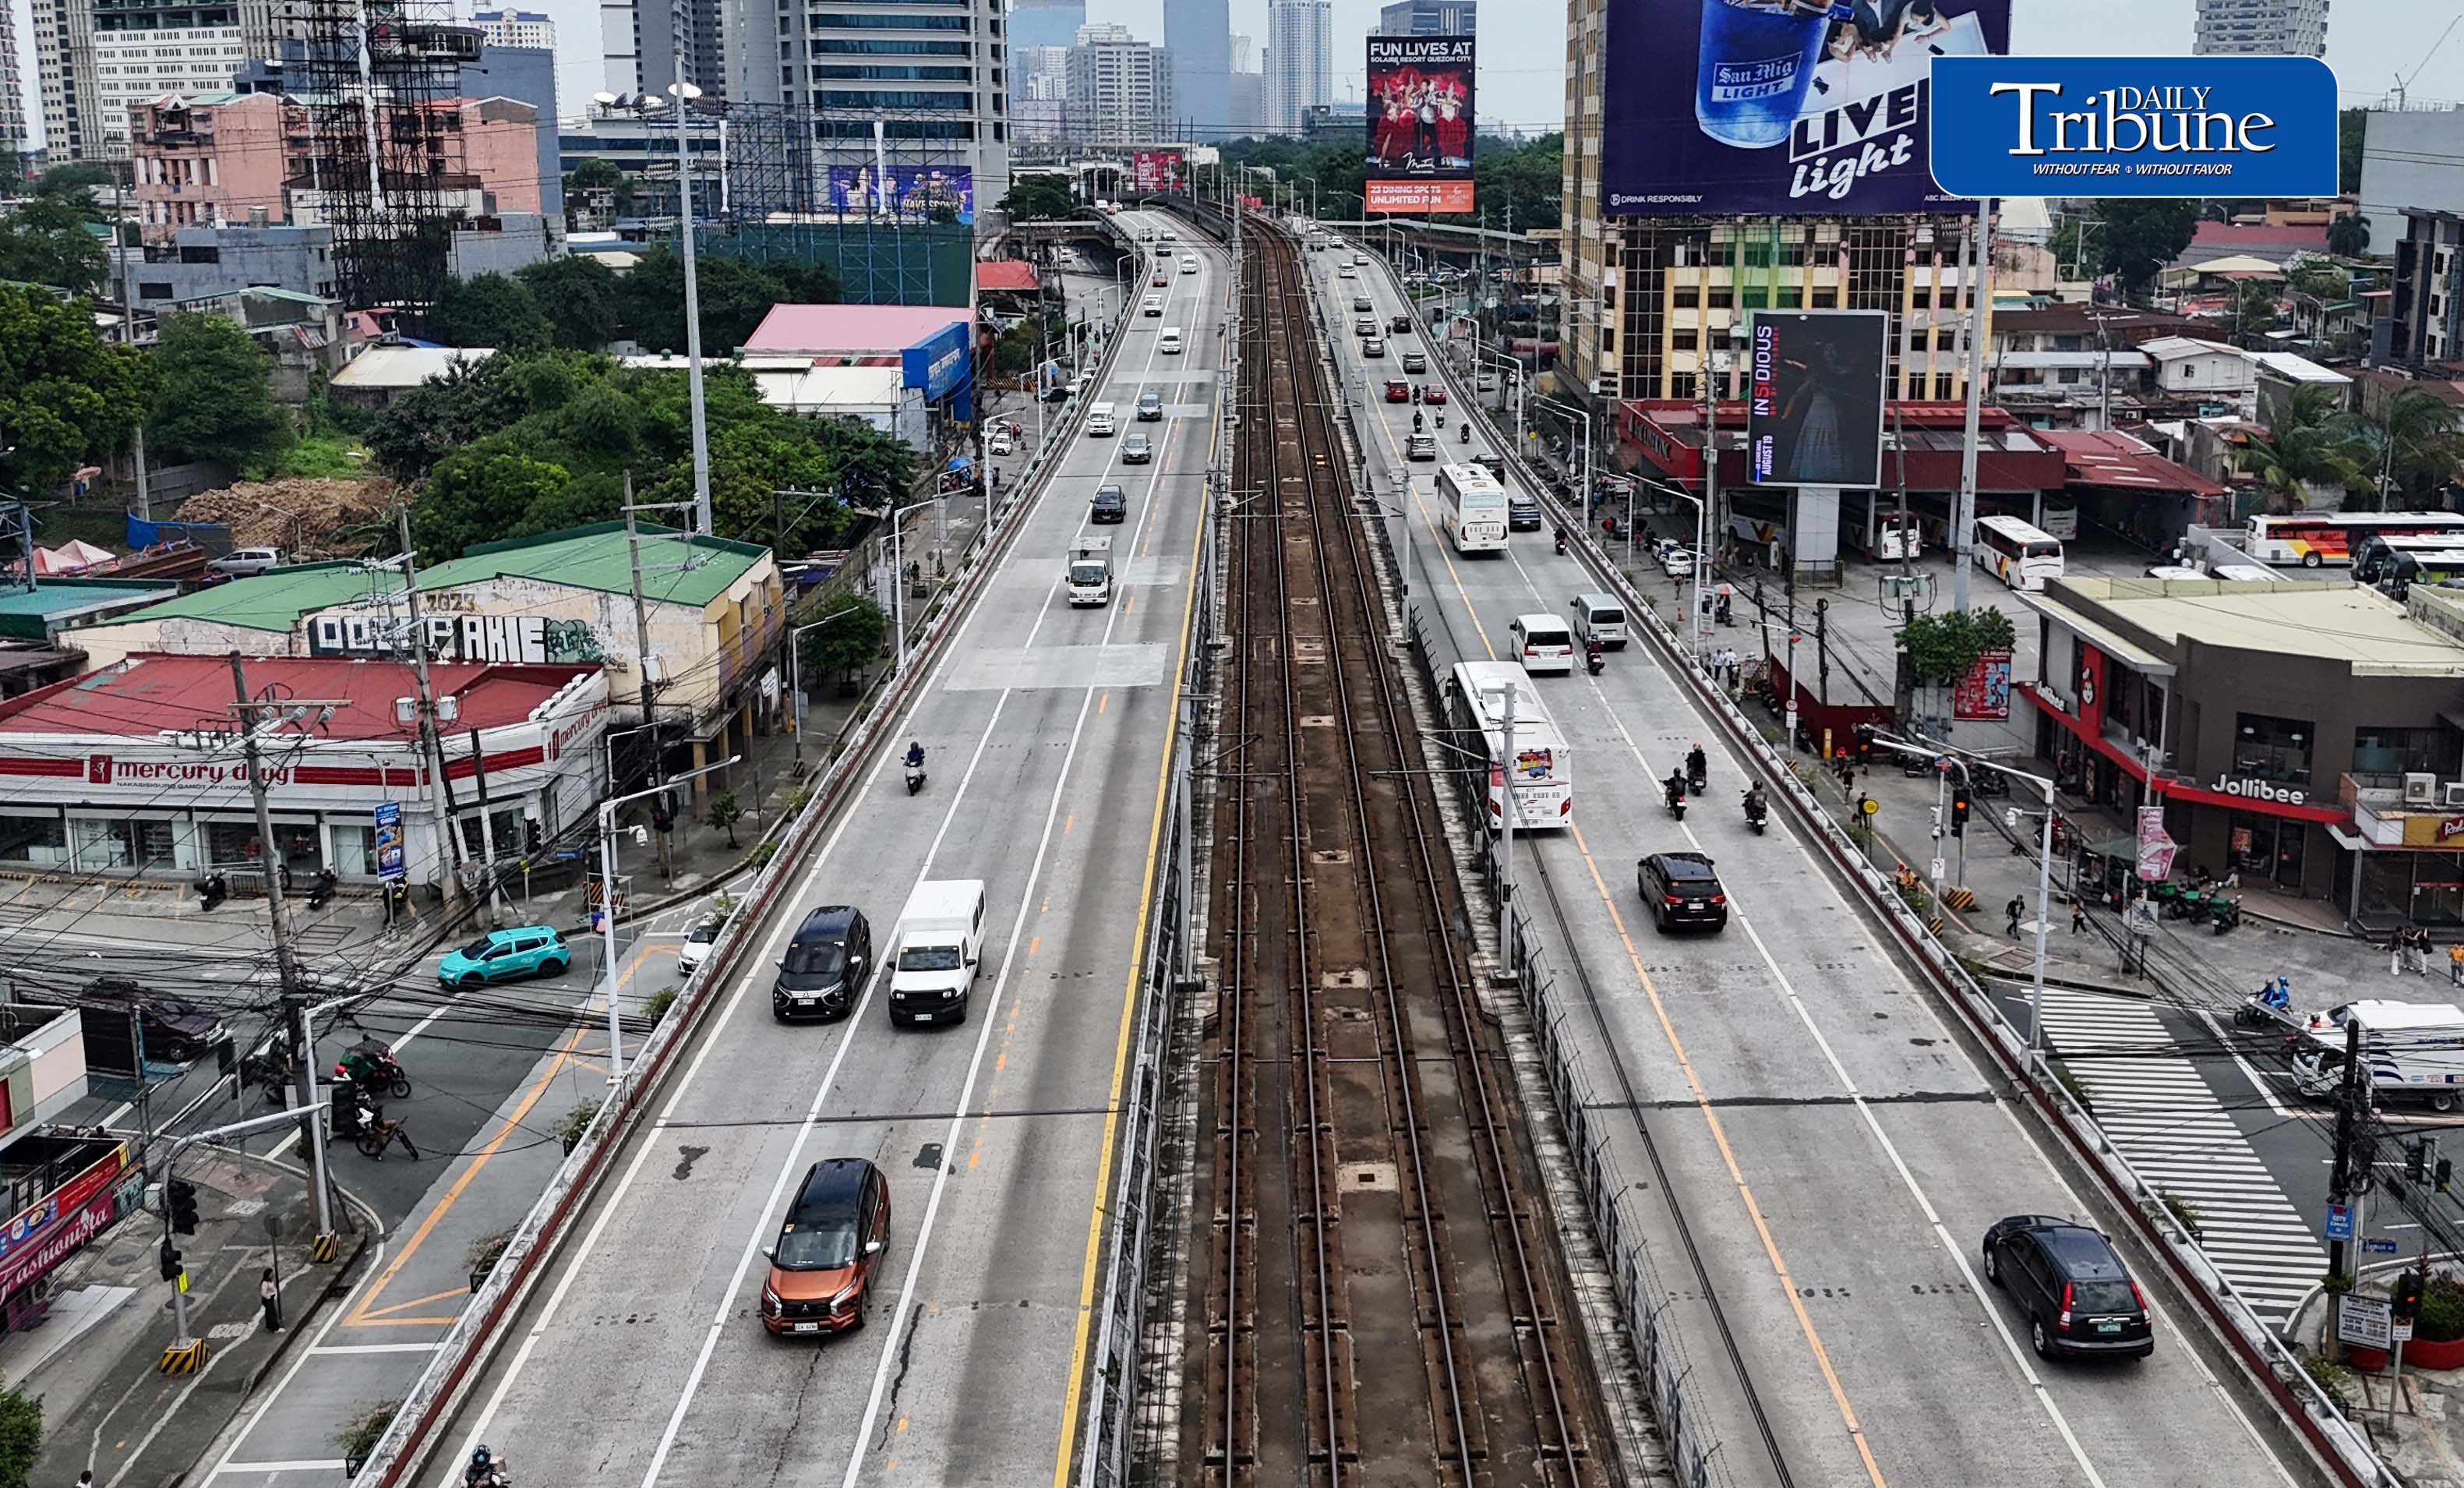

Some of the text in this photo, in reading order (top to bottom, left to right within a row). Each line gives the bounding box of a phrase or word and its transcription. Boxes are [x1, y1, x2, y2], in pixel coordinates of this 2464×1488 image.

[1370, 42, 1472, 56] FUN LIVES AT
[1719, 67, 1752, 83] San
[1722, 82, 1784, 99] LIGHT
[1793, 83, 1915, 154] LIVE
[1789, 133, 1914, 200] light
[1371, 196, 1420, 204] UNLIMITED
[1754, 325, 1772, 415] INSIDIOUS
[1761, 435, 1773, 475] AUGUST 19
[560, 710, 591, 747] mercury
[118, 763, 289, 785] mercury dug
[2212, 774, 2304, 805] Jollibee
